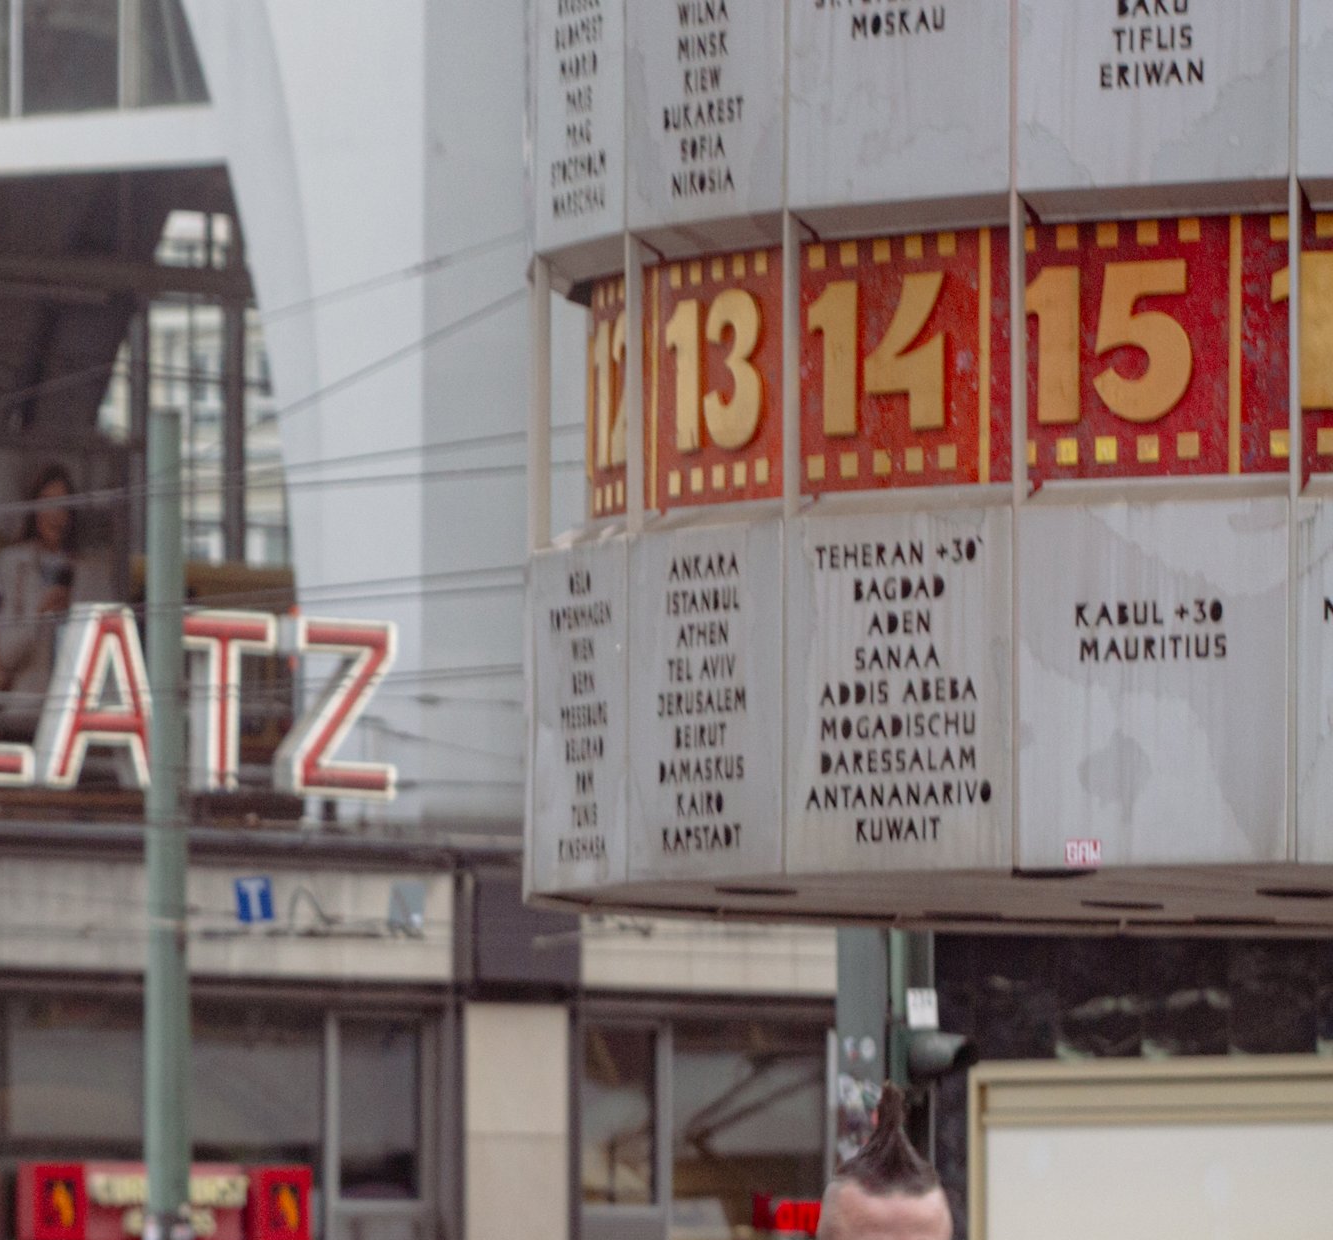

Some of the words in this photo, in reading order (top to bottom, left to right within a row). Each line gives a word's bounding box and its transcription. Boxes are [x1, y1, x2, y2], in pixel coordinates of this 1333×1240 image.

[678, 0, 729, 27] WILNA
[851, 6, 945, 40] MOSKAU
[1117, 0, 1188, 18] BAKU
[678, 31, 729, 61] MINSK
[1113, 25, 1193, 53] TIFLIS
[684, 66, 722, 94] KIEW
[1100, 58, 1204, 89] ERIWAN
[663, 96, 744, 132] BUKAREST
[680, 133, 725, 162] SOFIA
[672, 167, 735, 198] NIKOSIA
[809, 270, 946, 436] 14
[1026, 257, 1193, 424] 15
[665, 287, 763, 453] 13
[669, 552, 740, 582] ANKARA
[815, 541, 924, 569] TEHERAN
[666, 587, 741, 617] ISTANBUL
[853, 573, 945, 602] BAGDAD
[549, 600, 613, 633] KOPENHAGEN
[868, 609, 931, 636] ADEN
[1074, 601, 1164, 628] KABUL
[1174, 598, 1224, 623] +30
[677, 620, 730, 648] ATHEN
[1079, 634, 1227, 662] MAURITIUS
[668, 658, 693, 683] TEL
[699, 654, 736, 681] AVIV
[854, 644, 941, 671] SANAA
[656, 687, 748, 718] JERUSALEM
[820, 680, 888, 707] ADDIS
[902, 676, 978, 702] ABEBA
[675, 722, 728, 751] BEIRUT
[820, 711, 976, 742] MOGADISCHU
[659, 755, 745, 785] DAMASKUS
[820, 747, 976, 775] DARESSALAM
[677, 792, 724, 818] KAIRO
[805, 780, 993, 810] ANTANANARIVO
[662, 823, 742, 853] KAPSTADT
[855, 816, 941, 844] KUWAIT
[558, 835, 607, 864] KINSHASA
